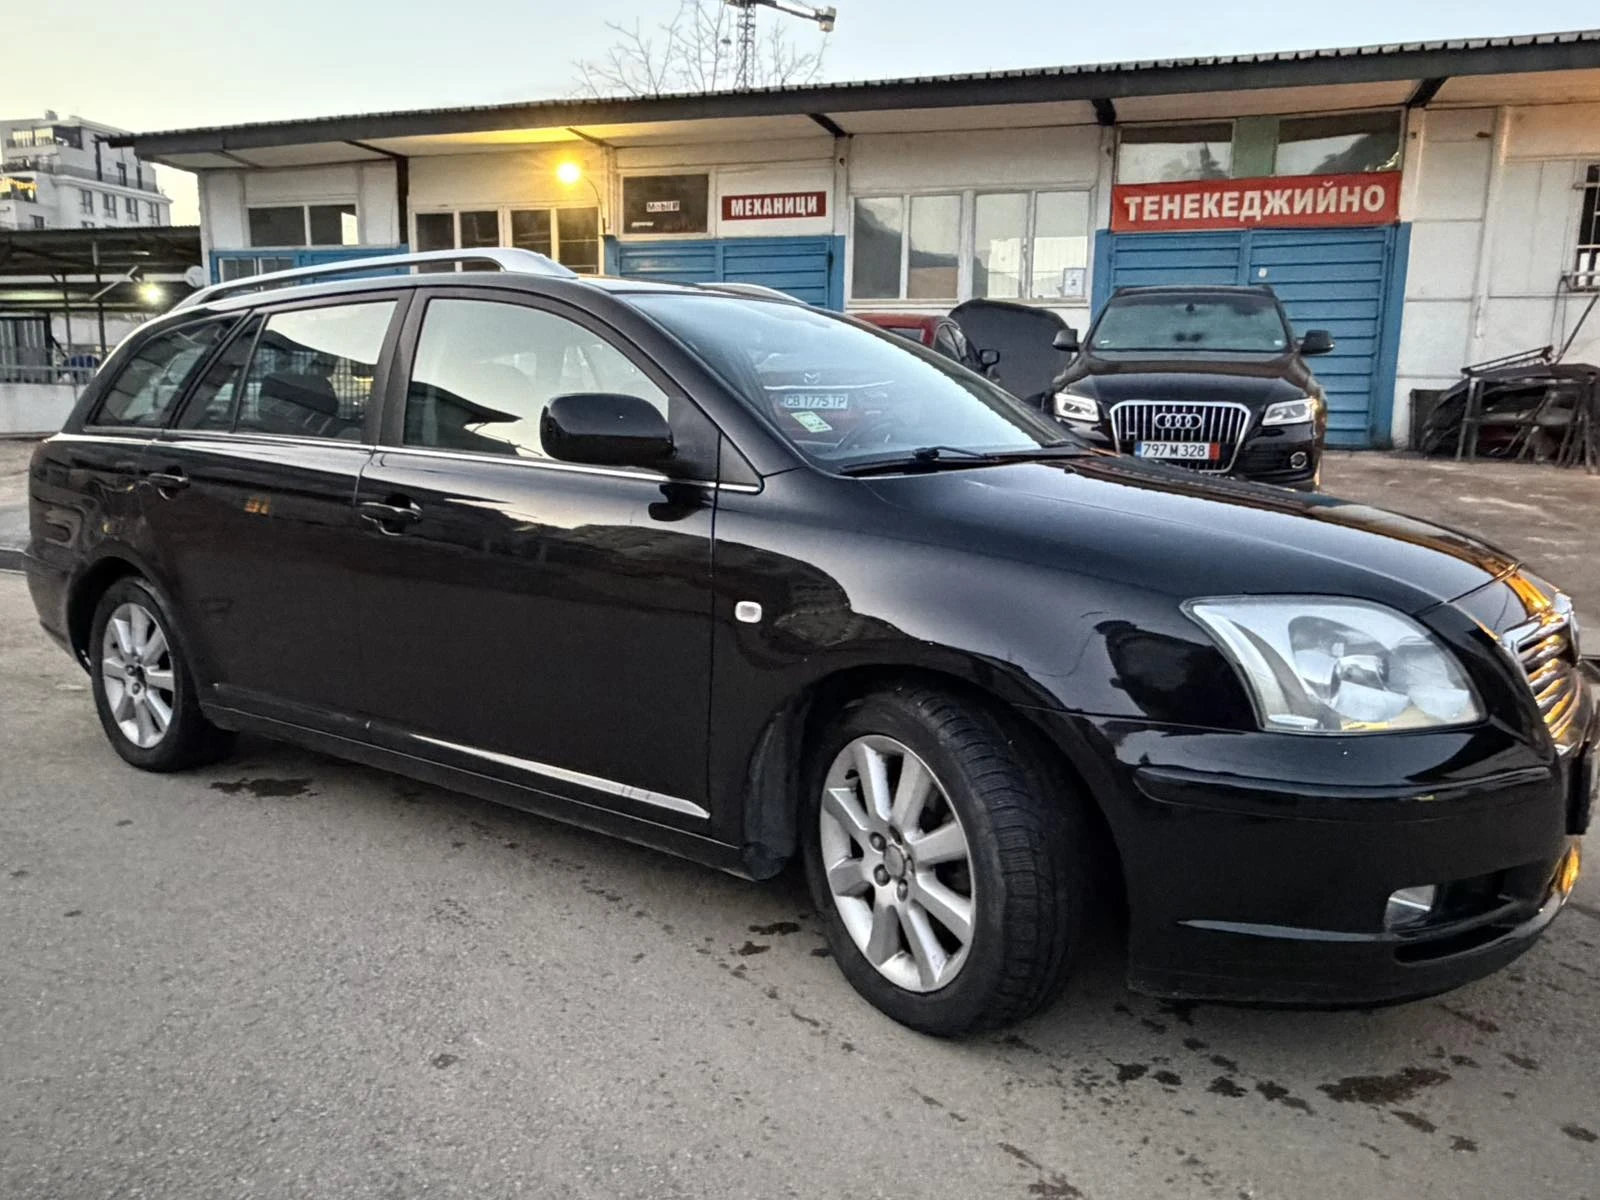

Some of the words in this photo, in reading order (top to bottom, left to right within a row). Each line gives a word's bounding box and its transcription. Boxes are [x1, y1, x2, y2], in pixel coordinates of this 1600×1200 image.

[730, 195, 818, 217] МЕХАНИЦИ
[1124, 181, 1386, 222] ТЕНЕКЕДЖИЙНО
[1143, 443, 1167, 457] 797
[1169, 444, 1179, 457] M
[1181, 444, 1206, 458] 328
